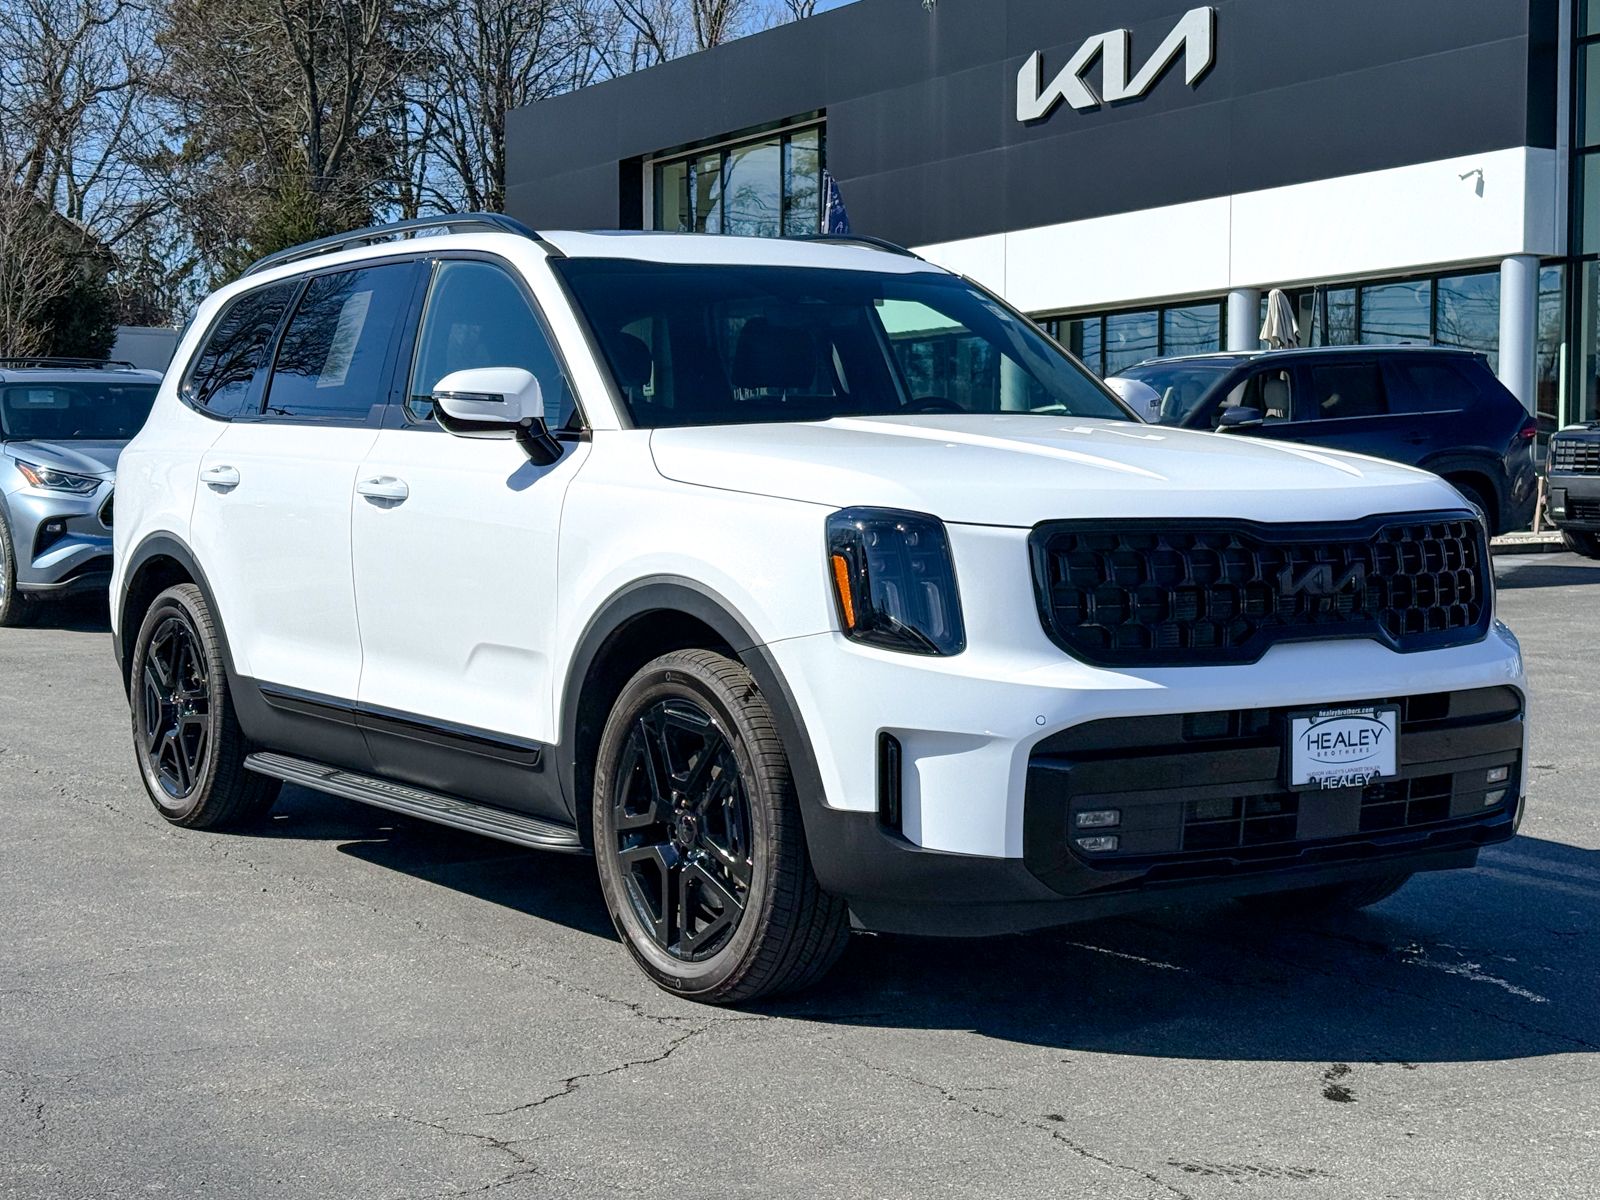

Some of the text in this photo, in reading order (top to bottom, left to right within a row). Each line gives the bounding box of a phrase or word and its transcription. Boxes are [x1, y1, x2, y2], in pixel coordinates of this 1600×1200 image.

[1017, 6, 1214, 121] KIA
[1278, 562, 1365, 595] KIA
[1319, 707, 1374, 717] healeybrothers.com
[1307, 727, 1383, 751] HEALEY
[1317, 748, 1369, 757] BROTHERS
[1321, 773, 1371, 790] HEALEY
